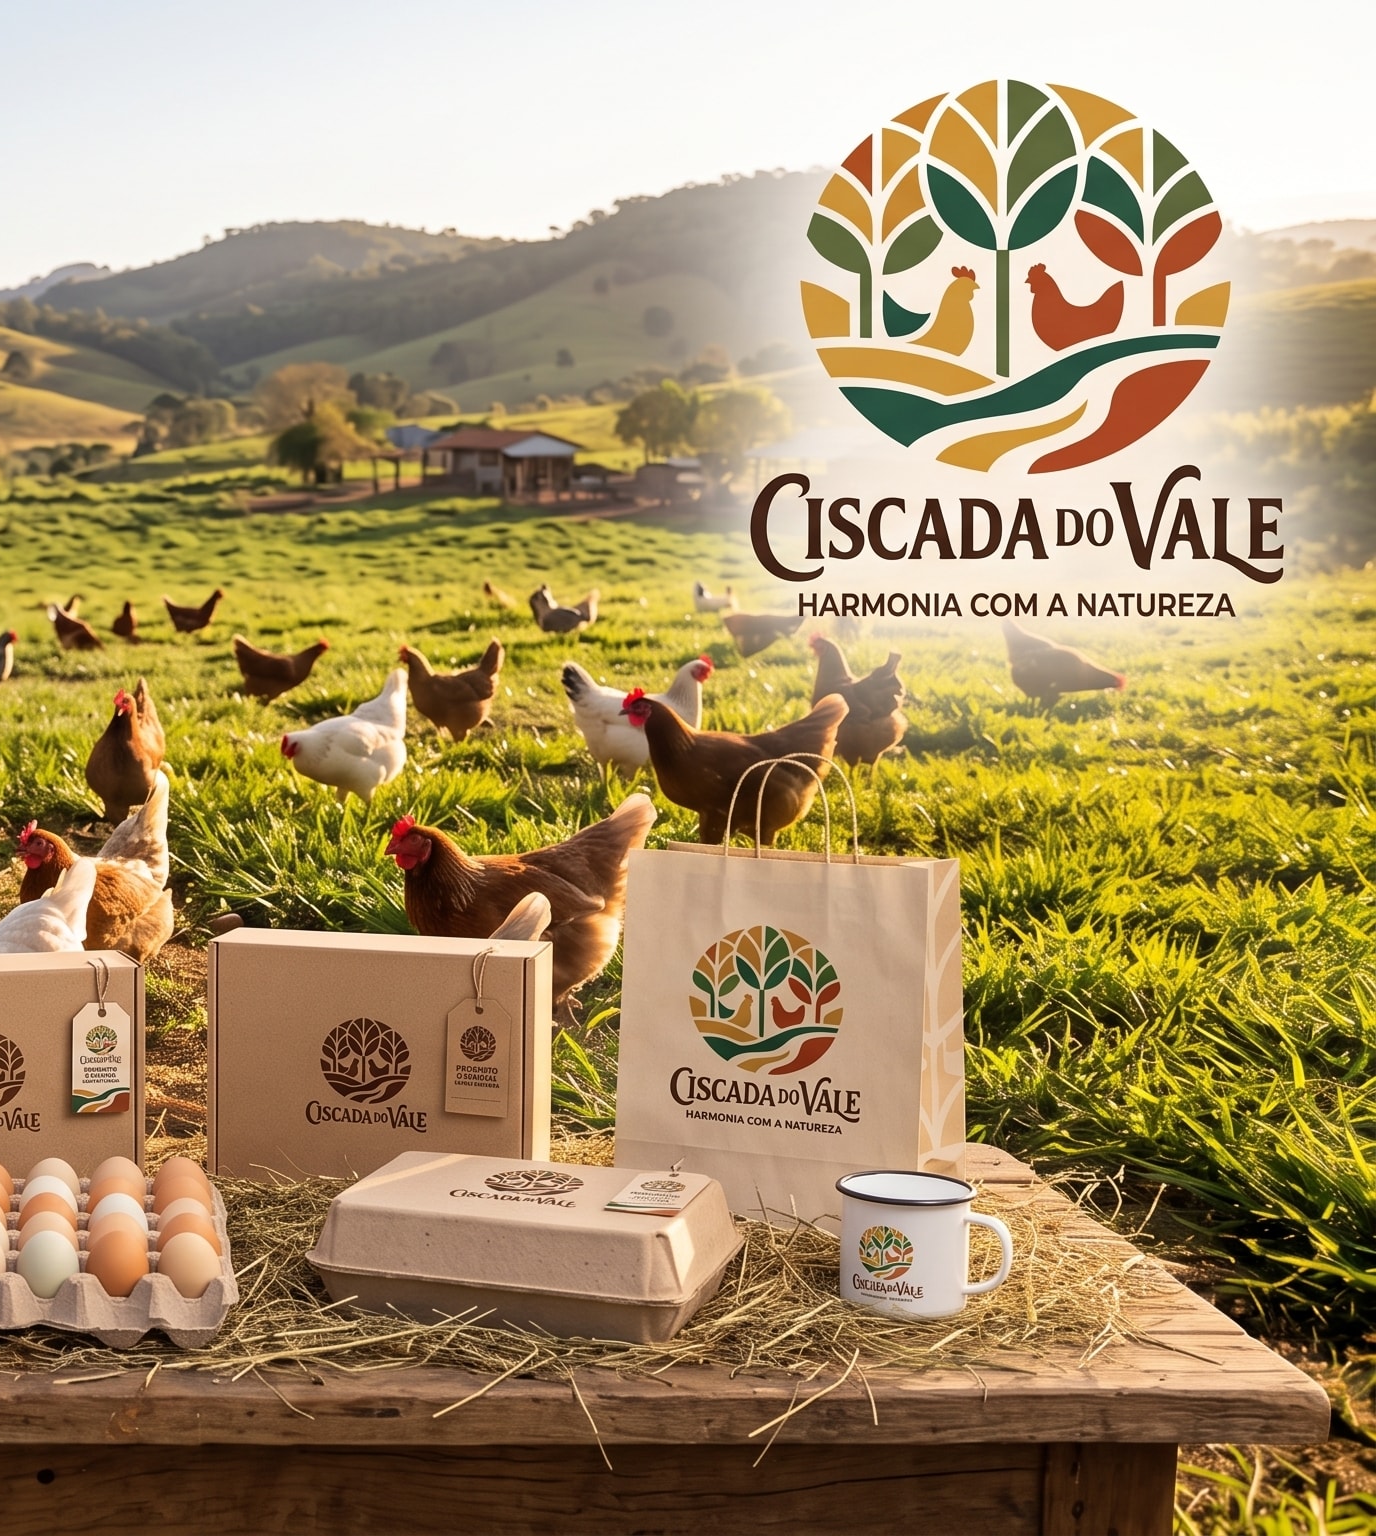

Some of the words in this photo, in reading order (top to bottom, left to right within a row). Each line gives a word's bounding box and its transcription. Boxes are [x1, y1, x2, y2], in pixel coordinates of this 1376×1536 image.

[669, 1066, 776, 1108] CISCADA
[777, 1088, 800, 1106] DO
[798, 1076, 861, 1124] VALE
[3, 1106, 41, 1133] VALE
[305, 1100, 374, 1126] CISCADA
[373, 1112, 389, 1124] DO
[386, 1104, 428, 1134] VALE
[685, 1109, 745, 1125] HARMONIA
[746, 1116, 772, 1128] COM
[774, 1119, 783, 1128] A
[784, 1120, 843, 1135] NATUREZA
